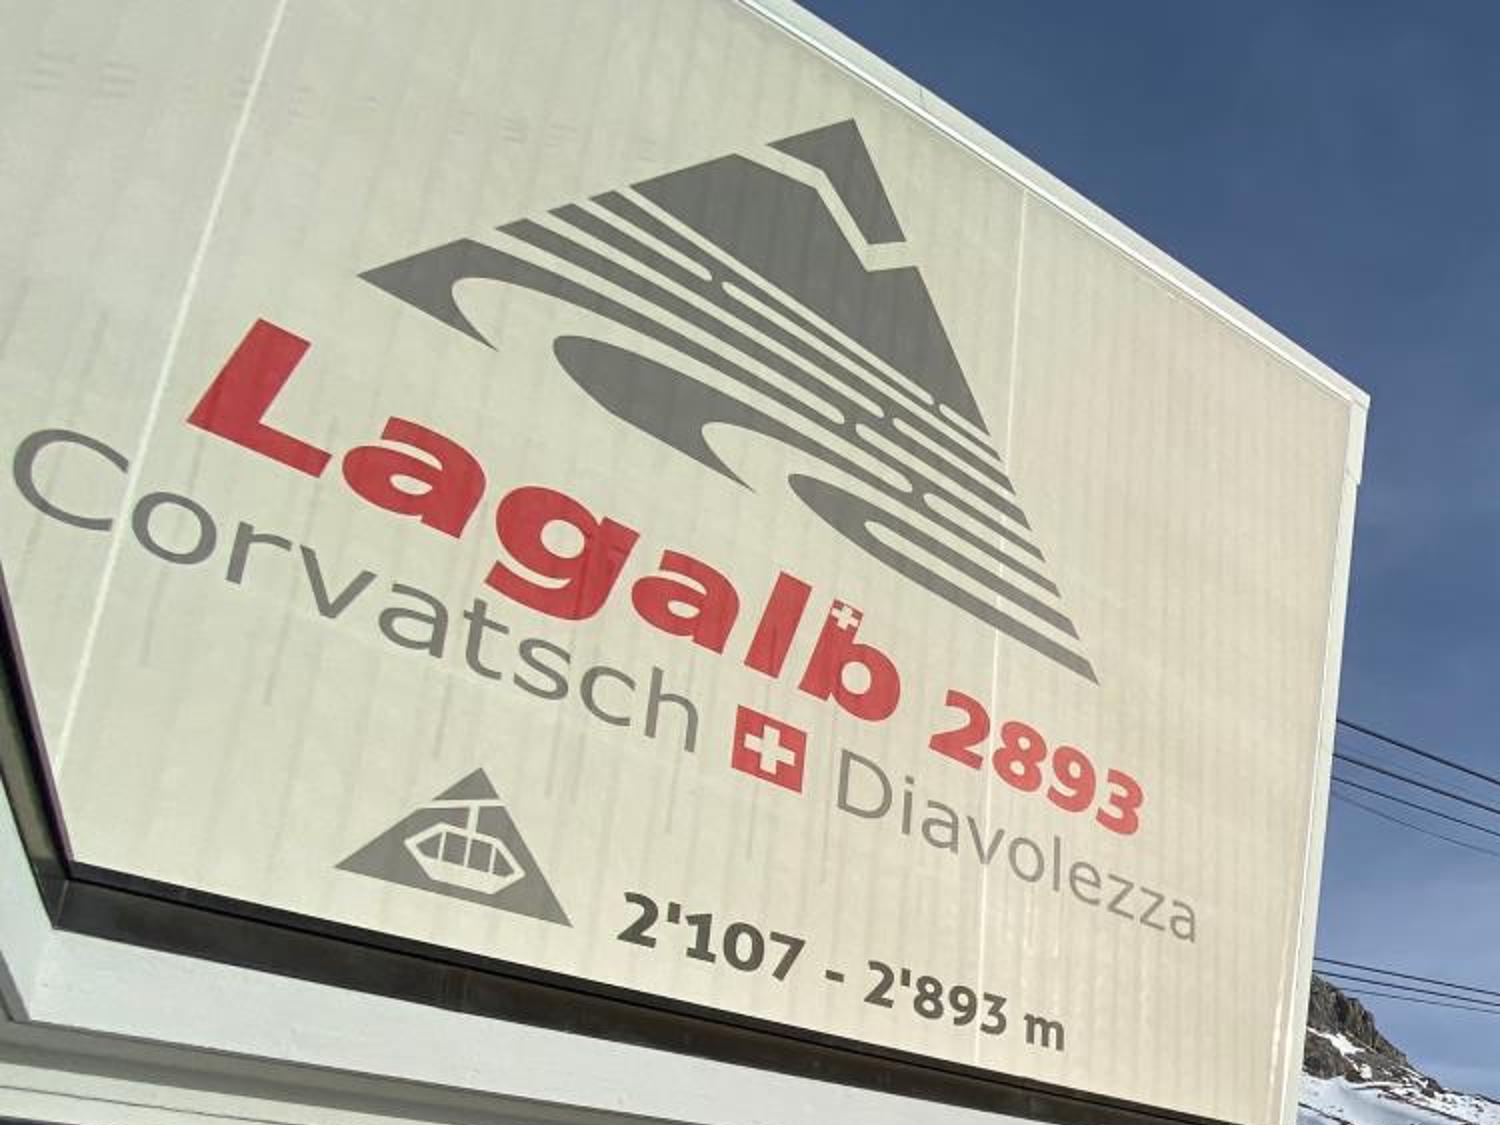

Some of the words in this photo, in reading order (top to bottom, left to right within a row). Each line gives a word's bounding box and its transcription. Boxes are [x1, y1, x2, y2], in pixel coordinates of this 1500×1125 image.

[12, 428, 699, 753] Corvatsch
[837, 749, 1197, 943] Diavolezza
[186, 318, 901, 721] Lagalb
[929, 689, 1144, 835] 2893
[617, 892, 806, 981] 2'107
[864, 961, 1008, 1036] 2'893
[1025, 1012, 1066, 1051] m
